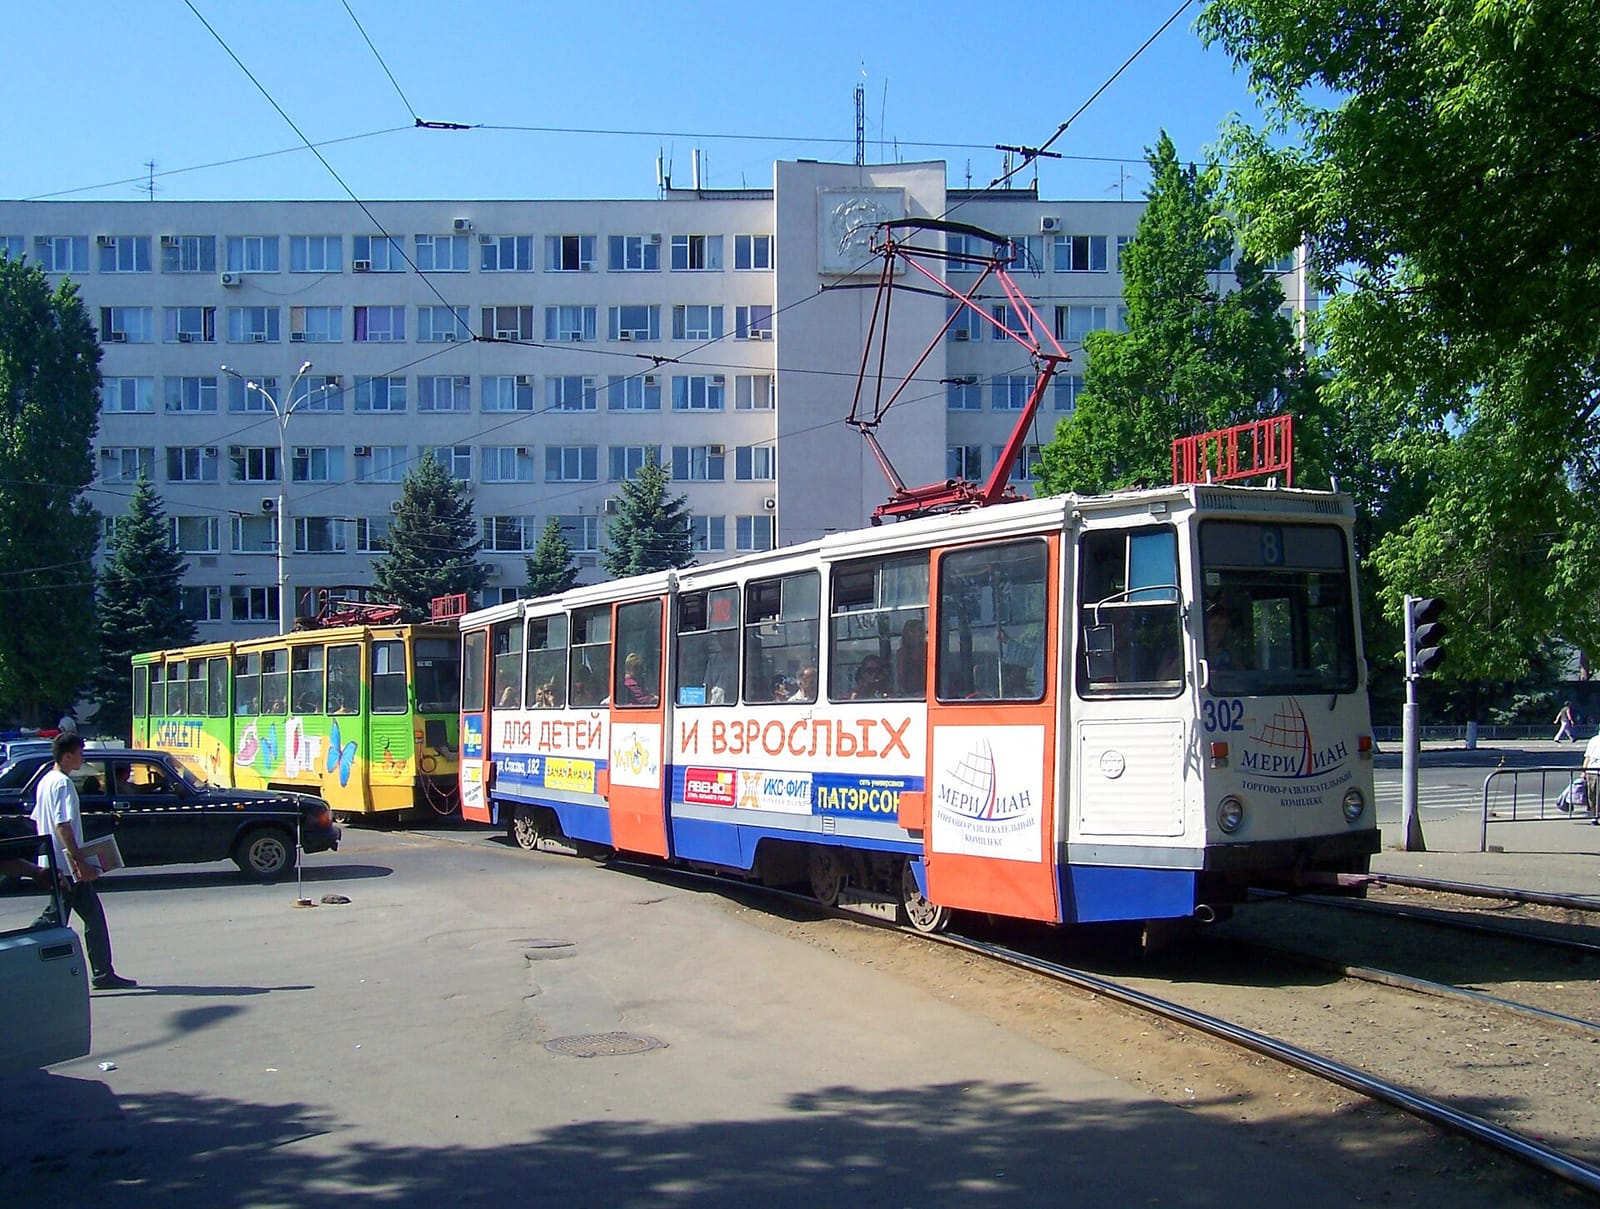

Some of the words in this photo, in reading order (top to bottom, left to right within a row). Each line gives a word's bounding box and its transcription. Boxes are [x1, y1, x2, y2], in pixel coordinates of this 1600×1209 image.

[1263, 530, 1278, 563] 8
[503, 720, 531, 750] ДЛЯ
[538, 712, 602, 751] ДЕТЕЙ
[1203, 699, 1244, 732] 302
[157, 720, 203, 748] SCARLETT
[681, 719, 699, 754] И
[711, 717, 911, 759] ВЗРОСЛЫХ
